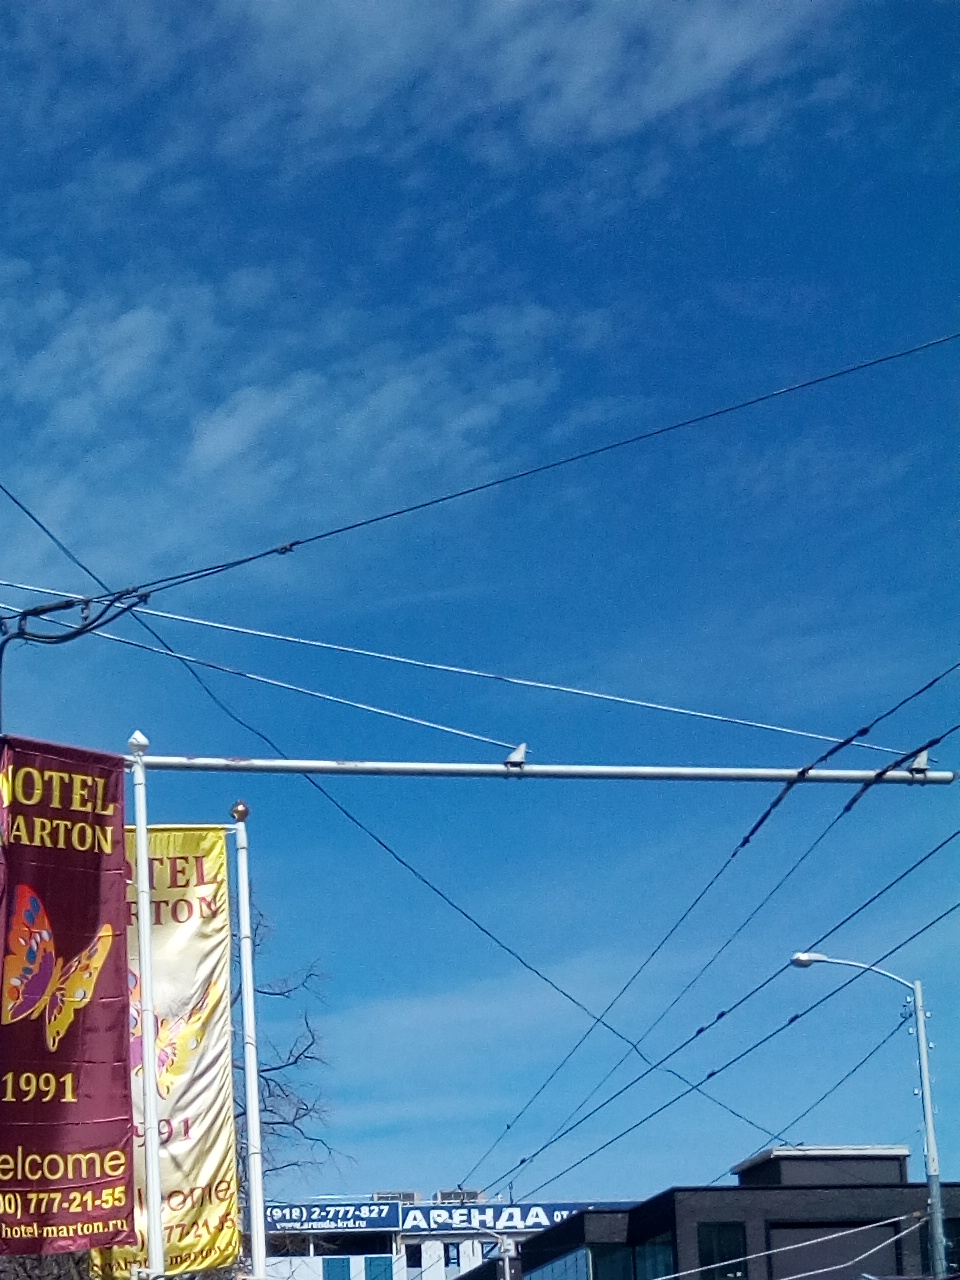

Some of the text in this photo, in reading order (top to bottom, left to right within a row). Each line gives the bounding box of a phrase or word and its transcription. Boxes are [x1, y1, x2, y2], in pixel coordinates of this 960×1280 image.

[8, 813, 114, 855] ARTON
[1, 1071, 79, 1103] 1991
[26, 1185, 127, 1214] 777-21-55
[310, 1205, 390, 1220] 2-777-827
[402, 1206, 551, 1230] АРЕНДА
